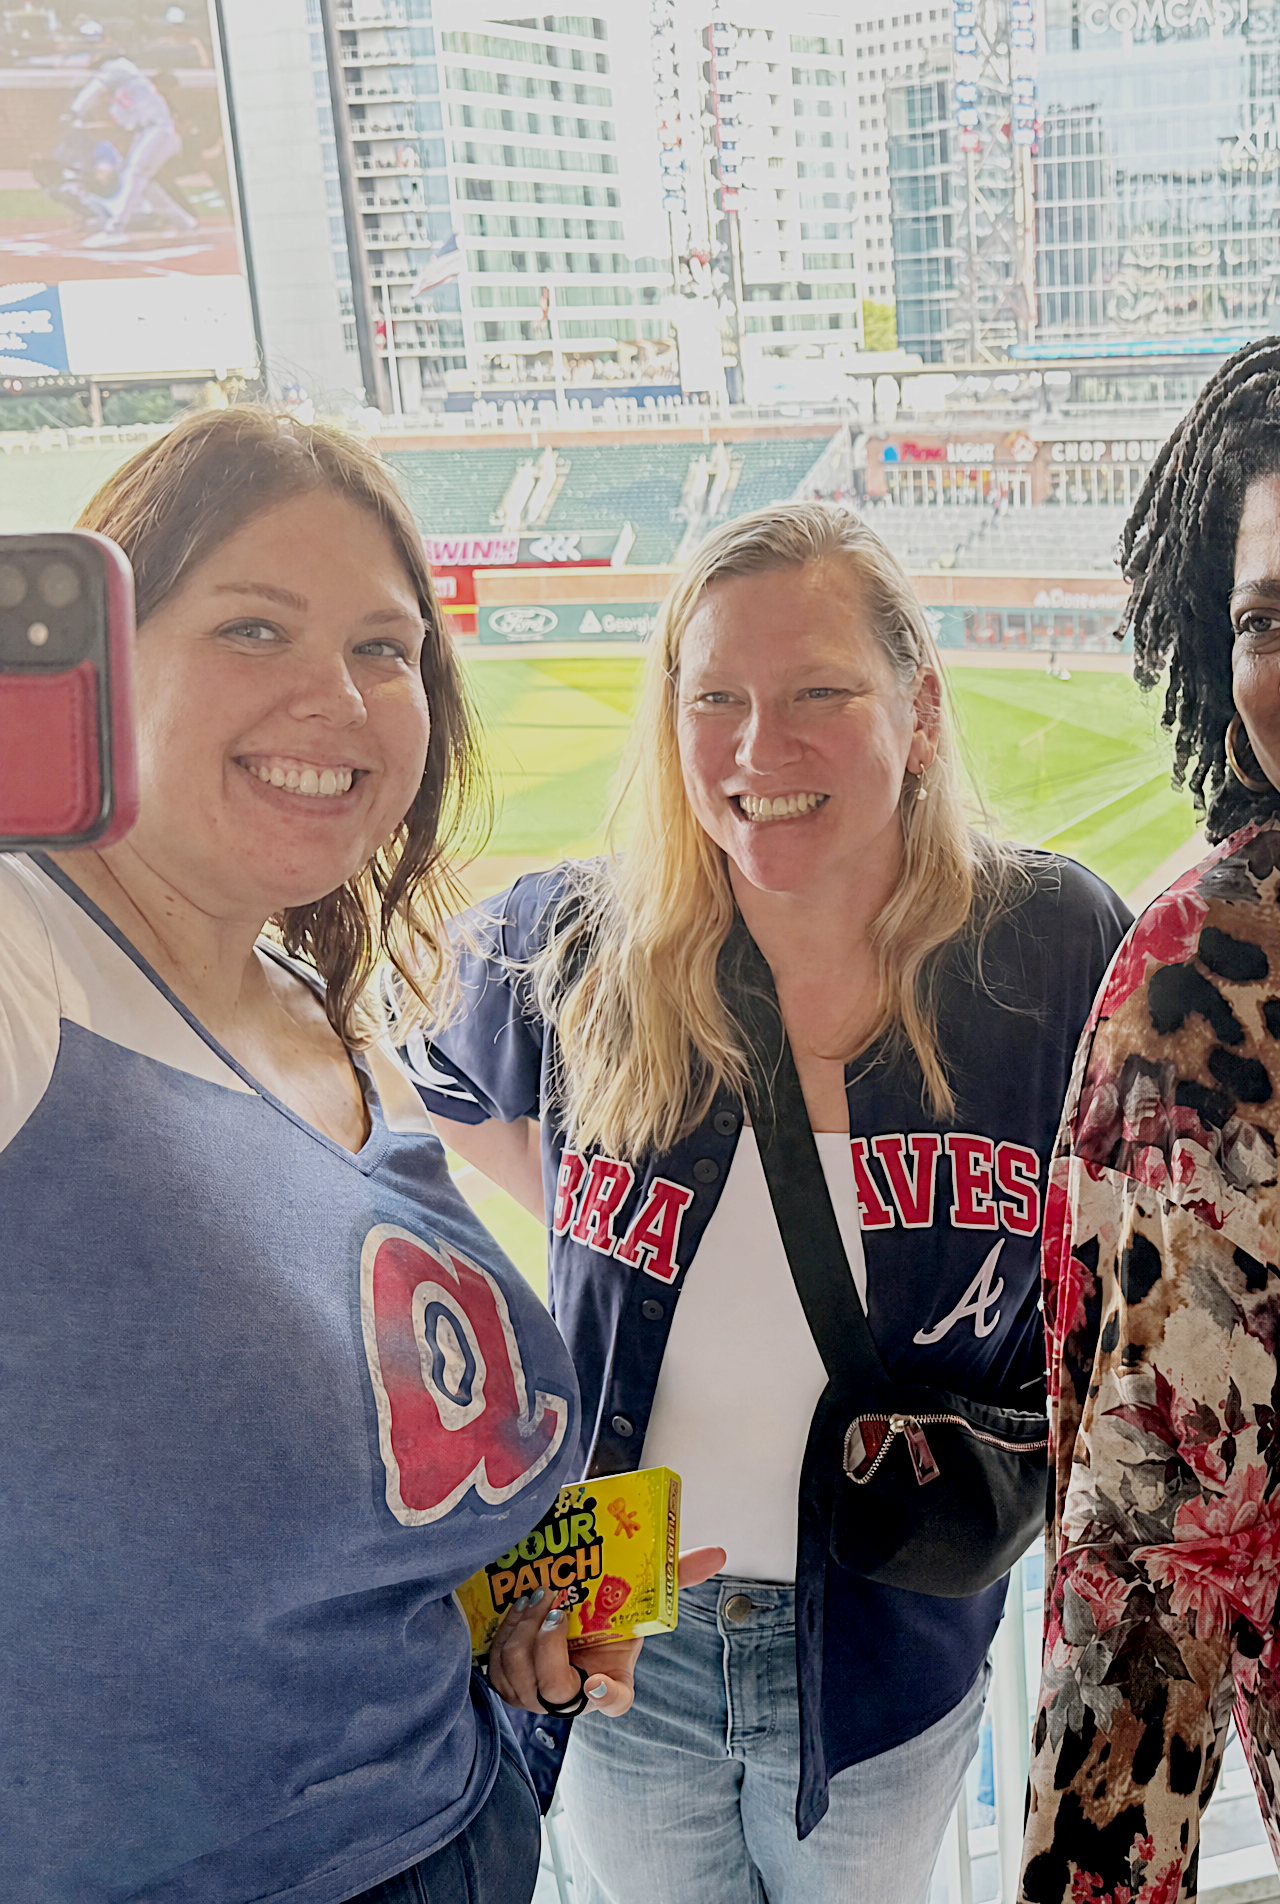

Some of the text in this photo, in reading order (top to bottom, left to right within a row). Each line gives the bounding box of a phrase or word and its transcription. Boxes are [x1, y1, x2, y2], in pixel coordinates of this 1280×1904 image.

[946, 442, 994, 463] LIGHT
[1051, 440, 1107, 462] CHOP
[500, 608, 547, 633] Ford
[913, 1237, 1006, 1345] A
[491, 1544, 601, 1606] PATCH
